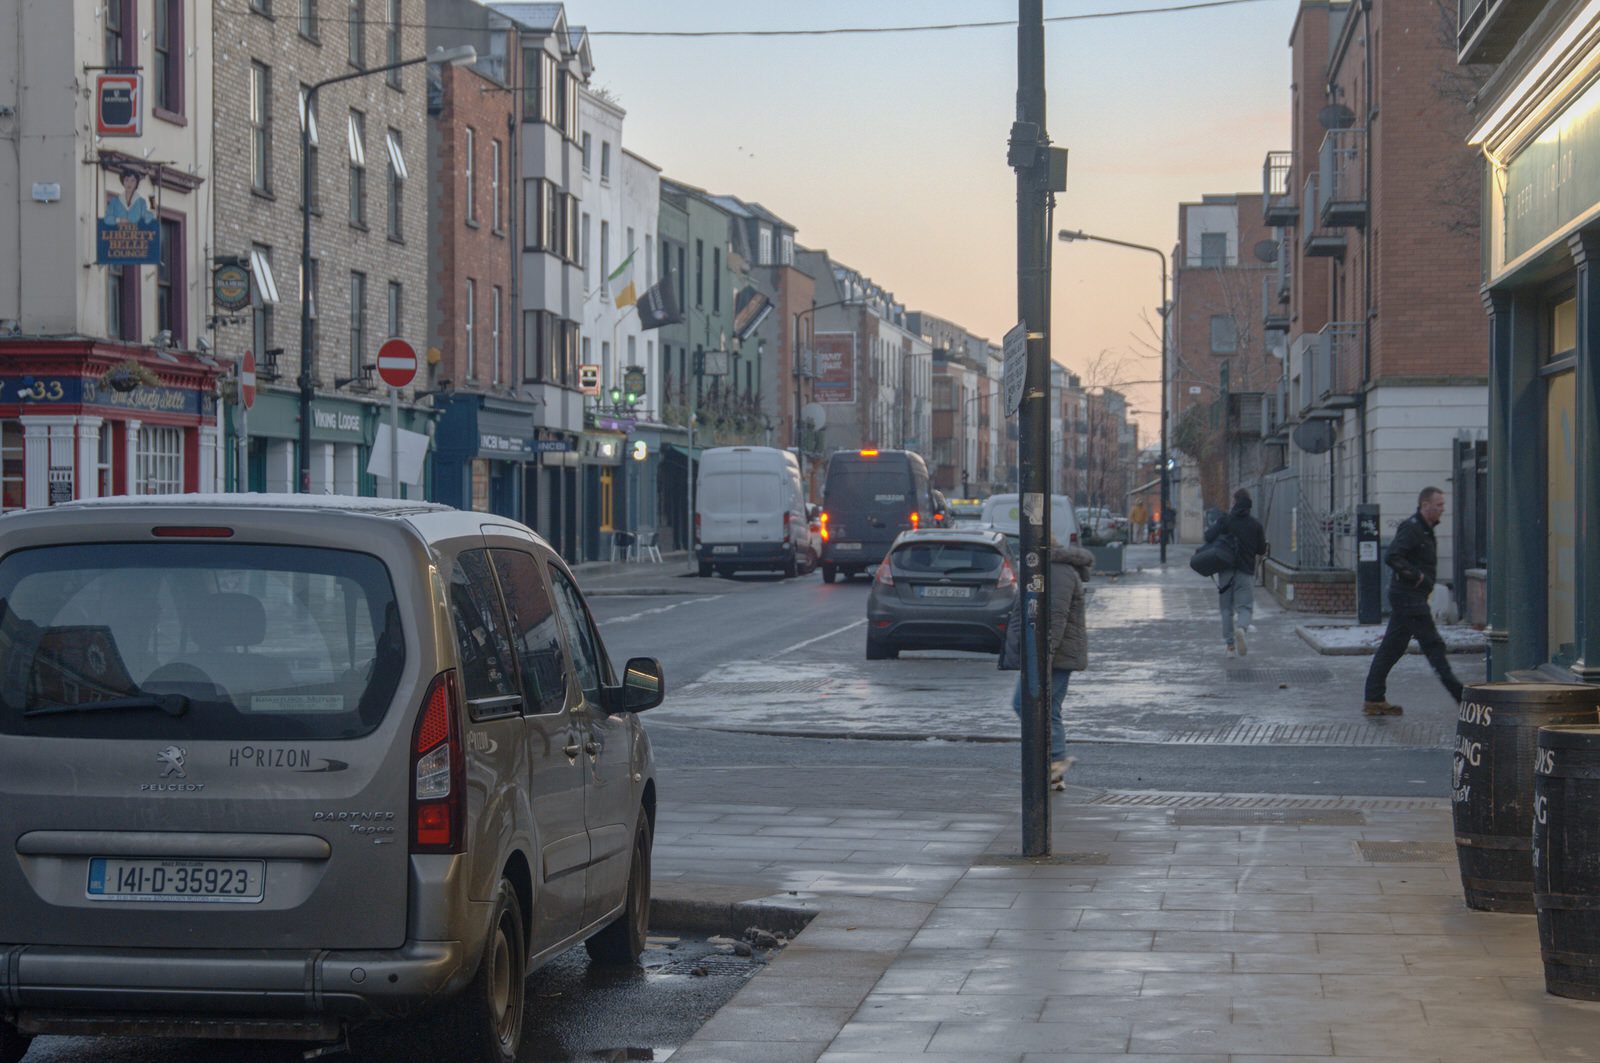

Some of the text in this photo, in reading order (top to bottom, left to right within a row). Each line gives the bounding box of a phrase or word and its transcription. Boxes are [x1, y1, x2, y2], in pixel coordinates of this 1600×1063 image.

[118, 223, 138, 231] THE
[102, 231, 156, 240] LIBERTY
[109, 240, 149, 249] BELLE
[107, 249, 148, 258] LOUNGE
[31, 381, 64, 400] 33
[84, 383, 96, 402] 33
[127, 389, 160, 410] Liberty
[314, 408, 360, 431] VIKING LODGE
[542, 442, 565, 450] NCBI
[229, 746, 310, 767] HORIZON
[140, 784, 205, 792] PEUGEOT
[312, 811, 395, 821] PARTNER
[350, 824, 394, 835] Tepee
[117, 867, 249, 894] 141-D-35923
